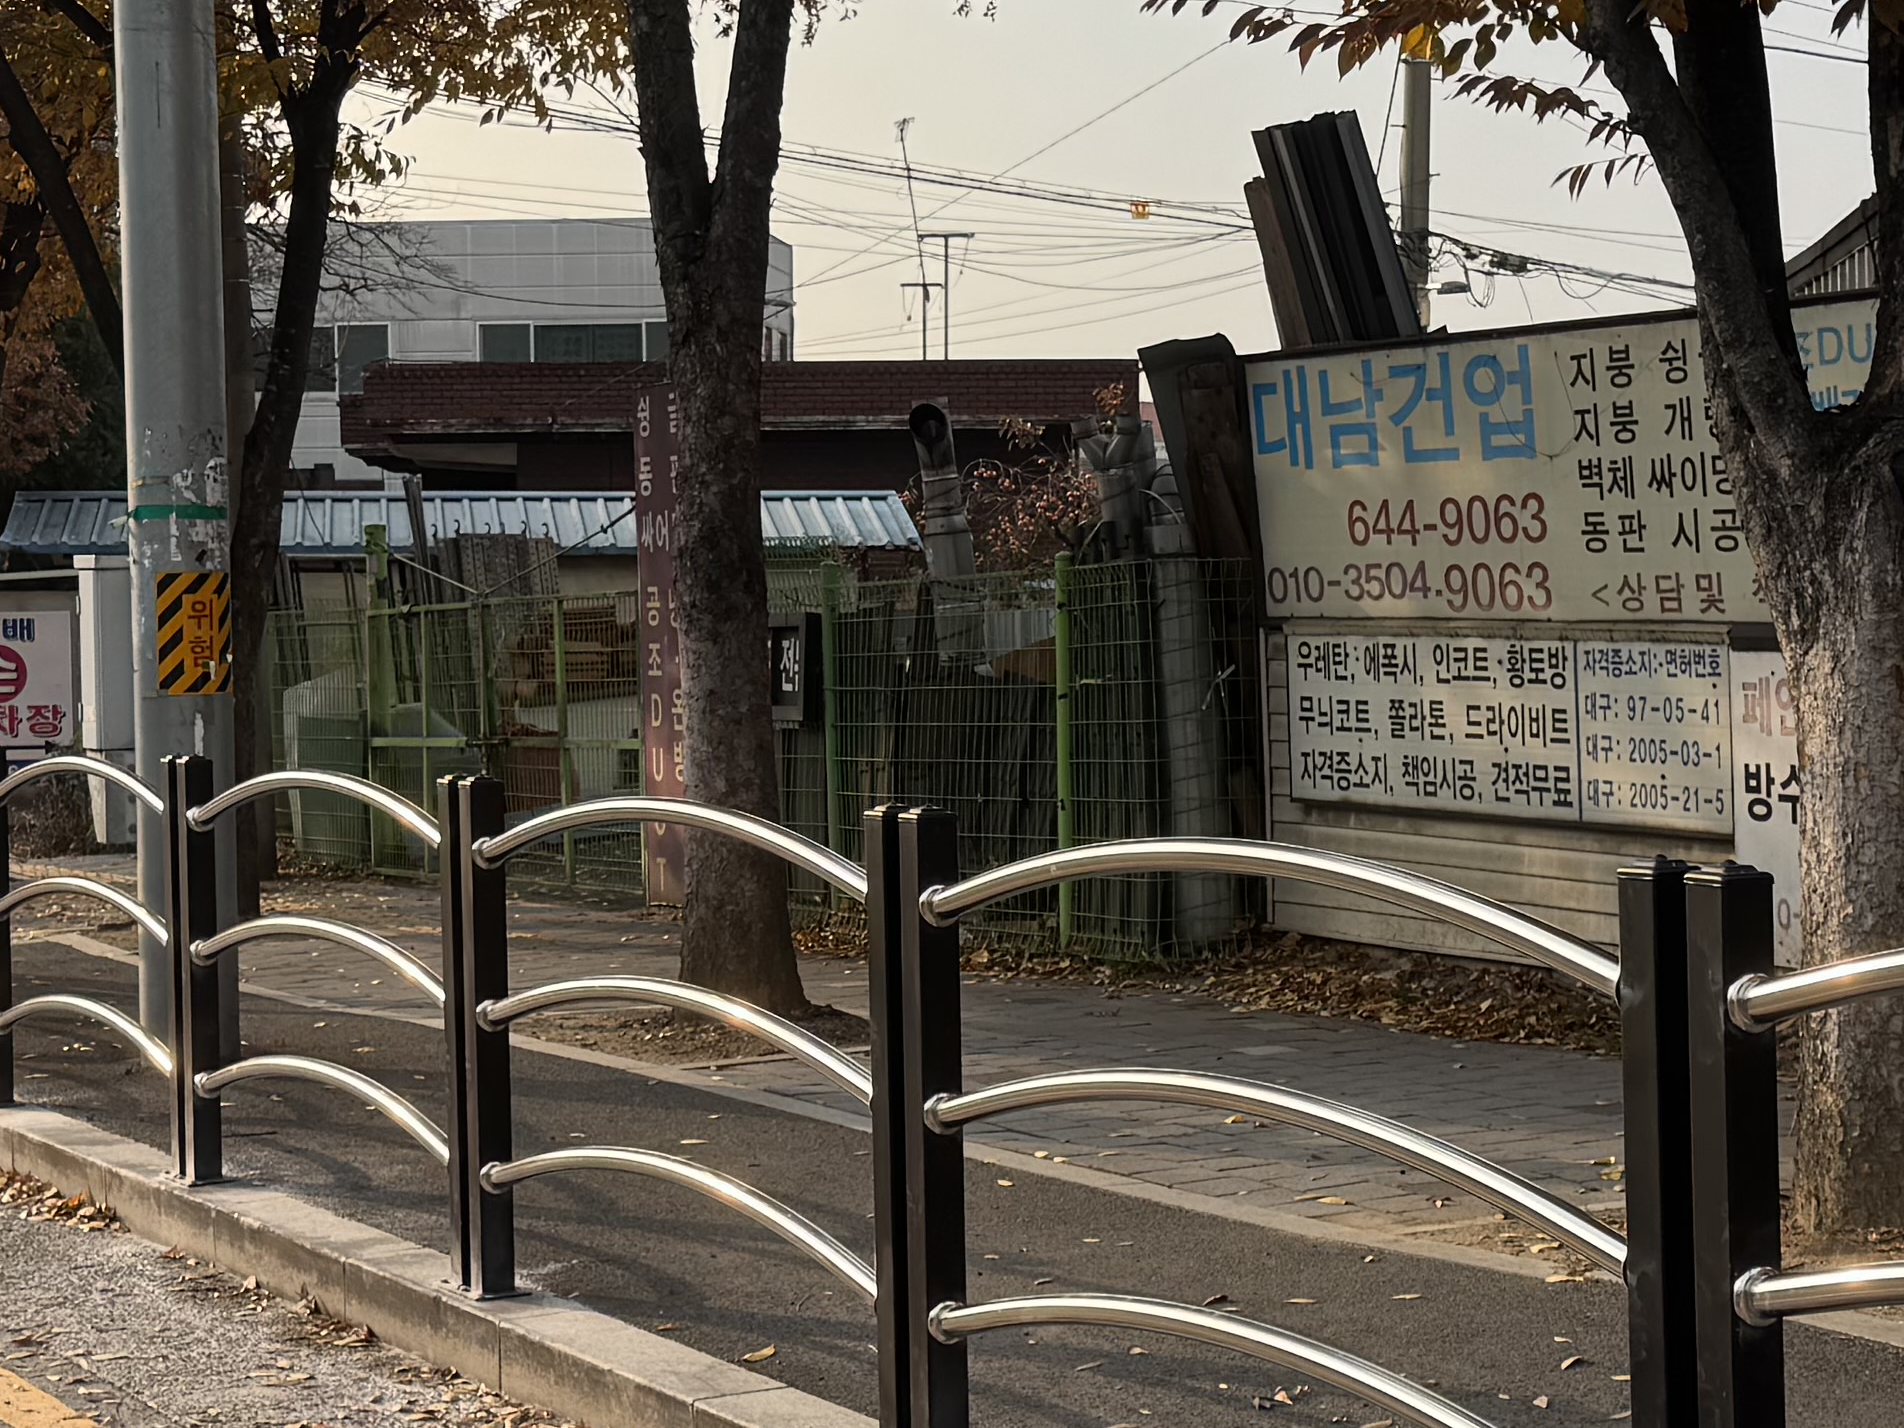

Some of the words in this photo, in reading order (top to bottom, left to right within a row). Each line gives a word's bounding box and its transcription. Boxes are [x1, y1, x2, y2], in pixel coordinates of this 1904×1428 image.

[1569, 344, 1635, 392] 지붕
[1252, 344, 1537, 470] 대남건업
[1573, 400, 1639, 447] 지붕
[1577, 455, 1636, 501] 벽체
[1347, 492, 1547, 547] 644-9063
[1581, 510, 1647, 554] 동판
[1671, 508, 1744, 554] 시공
[1506, 644, 1568, 689] 황토방
[1465, 702, 1571, 748] 드라이비트
[1584, 692, 1618, 721] 대구:
[1627, 695, 1720, 725] 97-05-41
[1586, 733, 1621, 763] 대구:
[1628, 737, 1722, 769] 2005-03-1
[1491, 760, 1573, 808] 견적무료
[1587, 778, 1622, 809] 대구:
[1629, 782, 1724, 815] 2005-21-5
